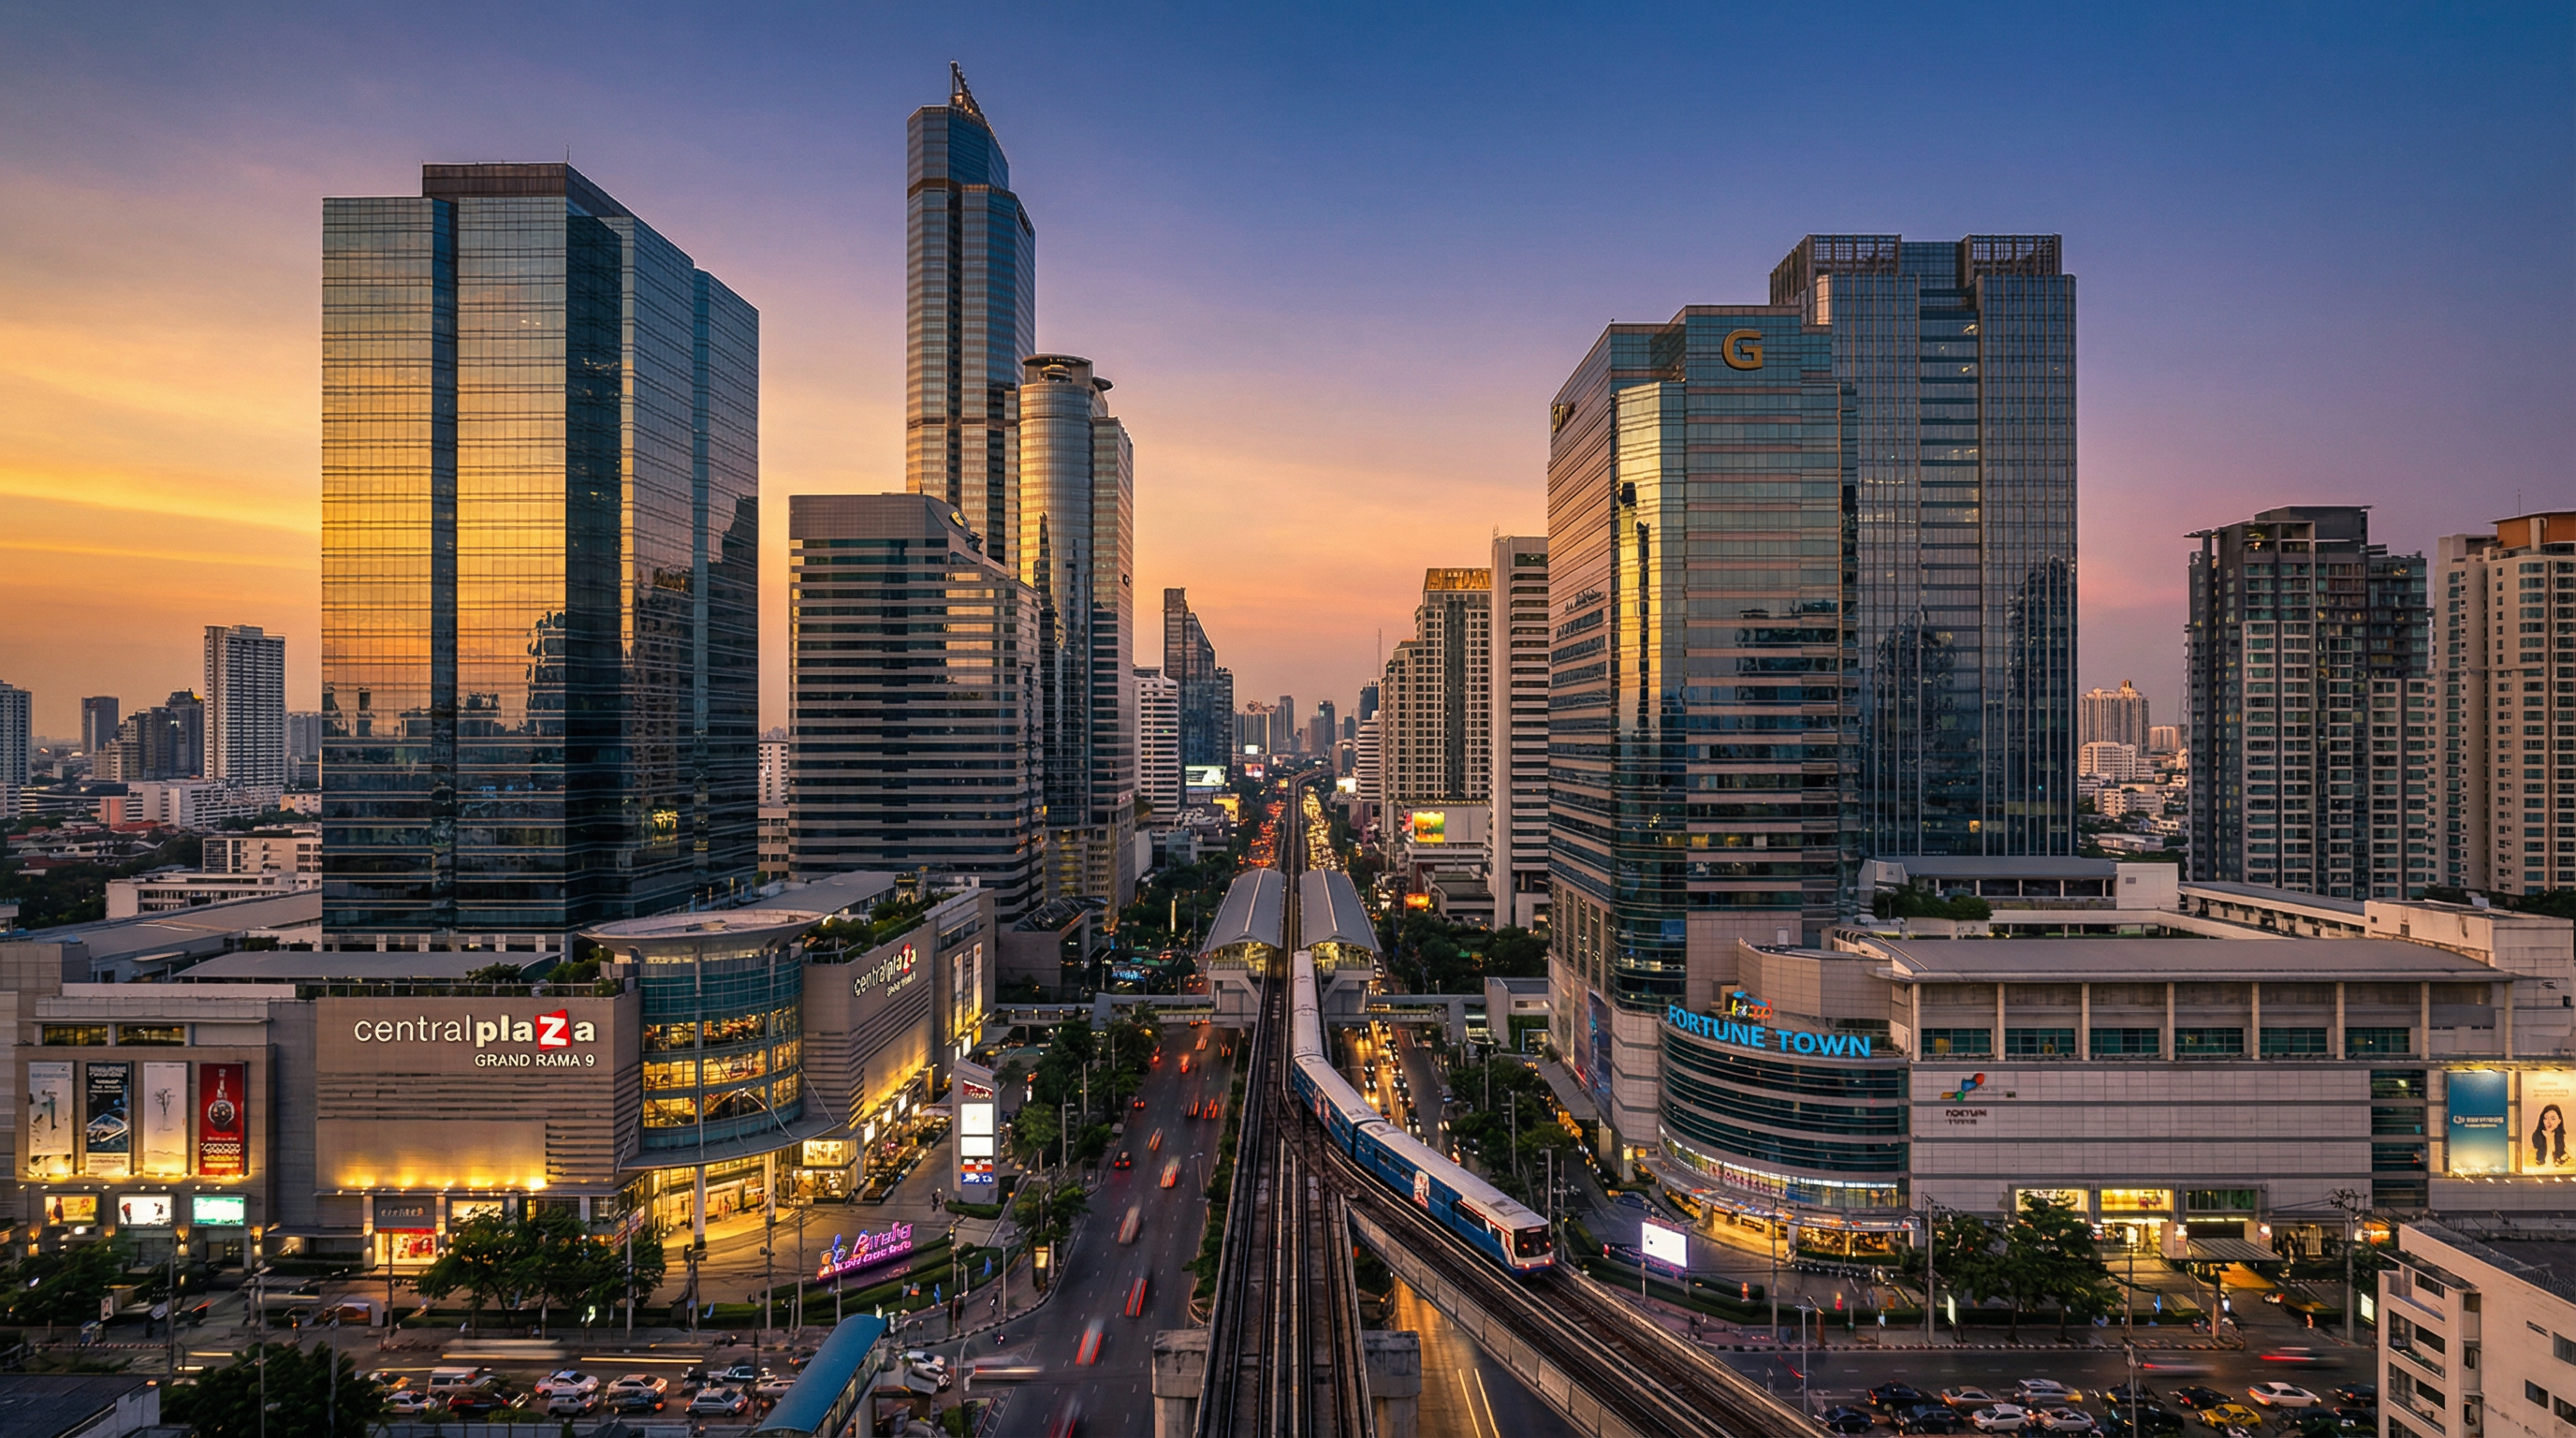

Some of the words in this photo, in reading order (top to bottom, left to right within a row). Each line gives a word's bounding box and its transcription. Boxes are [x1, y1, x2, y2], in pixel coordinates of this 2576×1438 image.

[1720, 329, 1764, 371] G
[1668, 1005, 1766, 1049] FORTUNE
[1776, 1029, 1871, 1058] TOWN
[475, 1054, 531, 1067] GRAND
[535, 1054, 581, 1067] RAMA
[585, 1054, 596, 1067] 9
